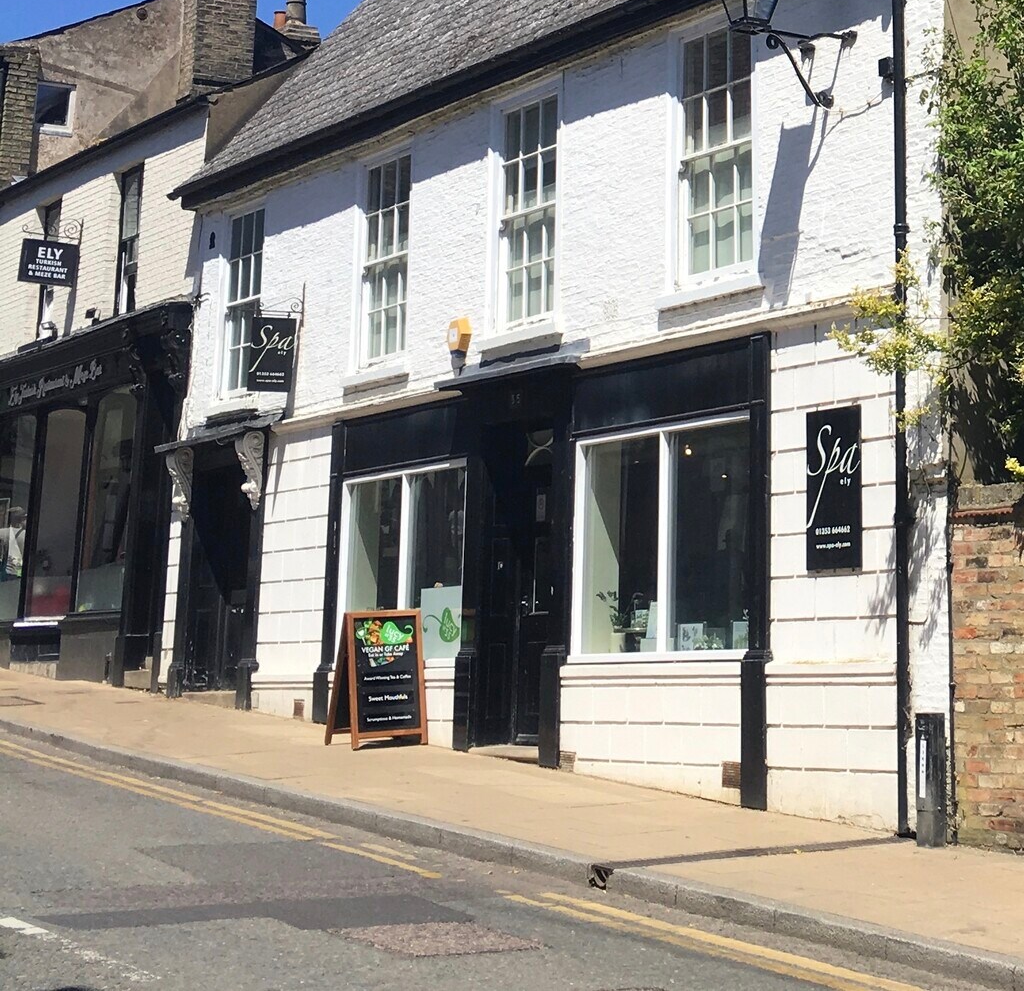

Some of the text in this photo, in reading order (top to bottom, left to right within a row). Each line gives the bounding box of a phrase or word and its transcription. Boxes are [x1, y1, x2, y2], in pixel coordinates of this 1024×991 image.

[37, 246, 64, 260] ELY
[35, 258, 62, 266] TURKISH
[27, 263, 68, 273] RESTAURANT
[248, 325, 295, 372] Spa
[806, 424, 861, 529] Spa
[839, 477, 851, 487] ely
[815, 525, 851, 536] 01353 664662
[386, 624, 405, 641] lucy
[361, 643, 410, 654] VEGAN GF CAFÉ
